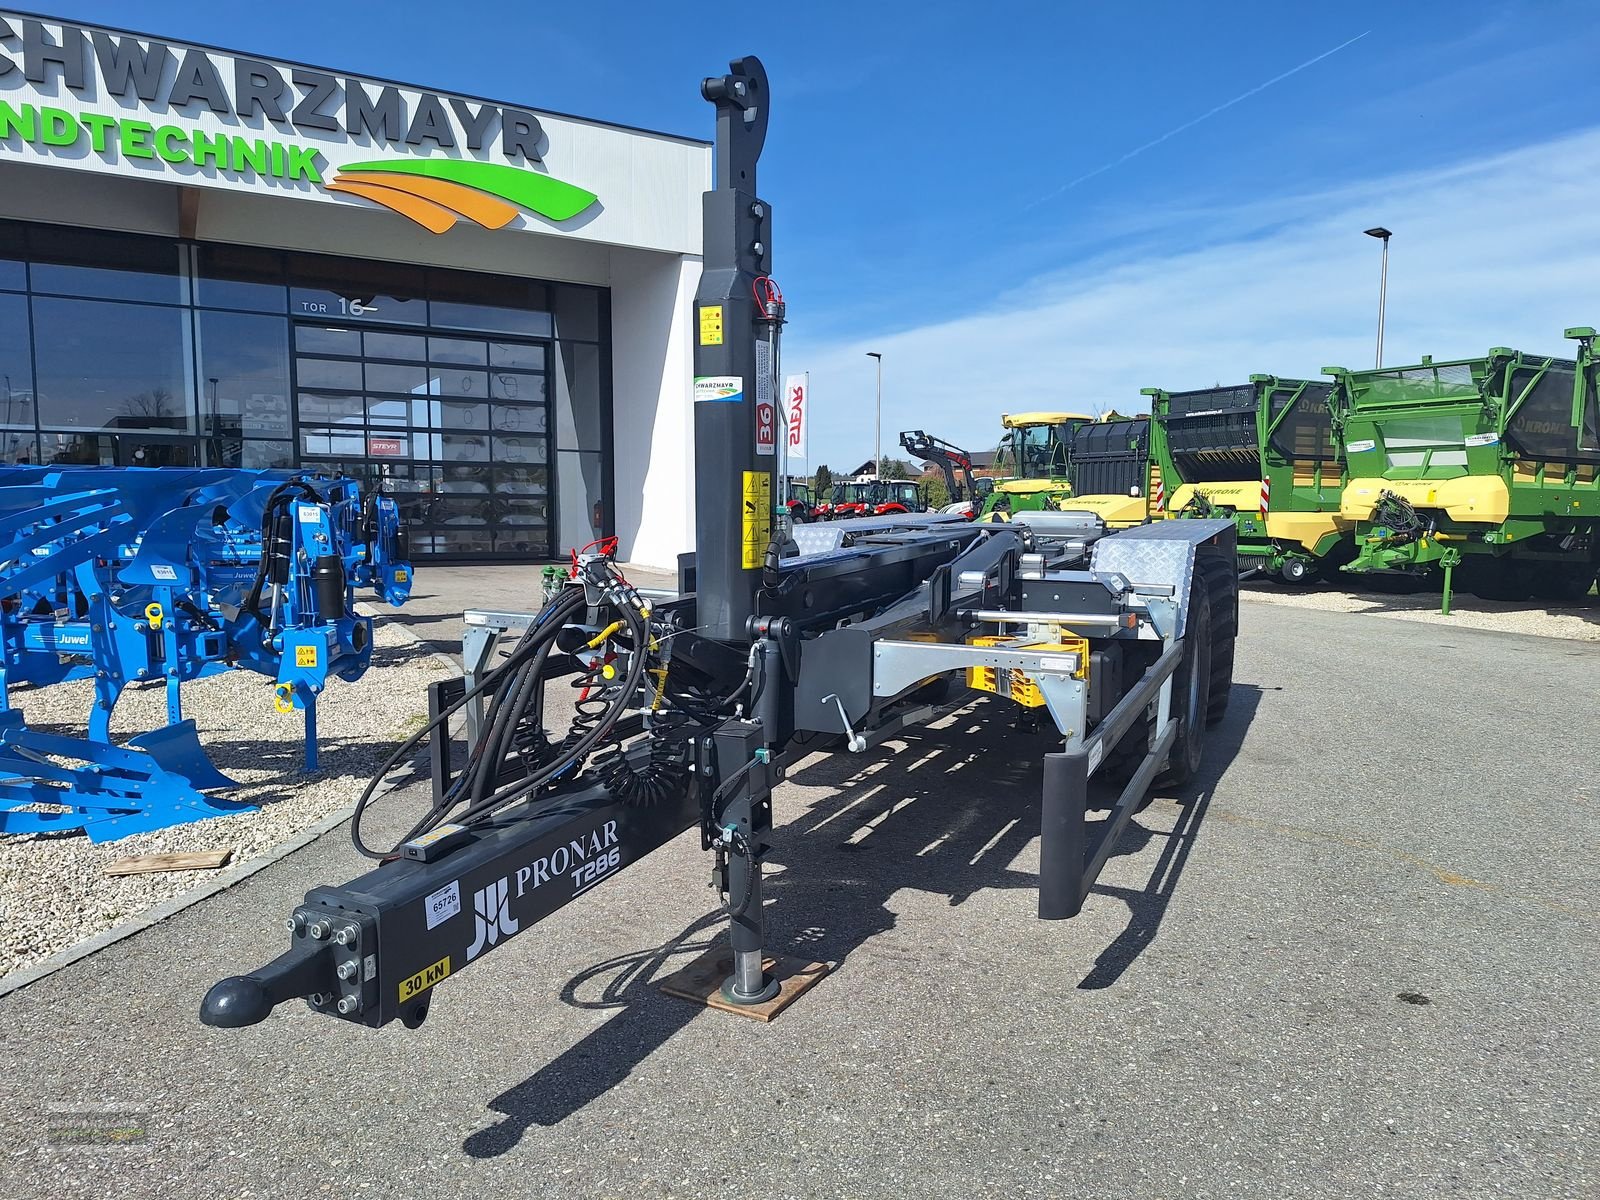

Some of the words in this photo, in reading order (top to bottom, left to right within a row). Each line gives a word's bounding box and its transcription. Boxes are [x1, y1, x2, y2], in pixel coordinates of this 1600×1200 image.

[302, 302, 327, 313] TOR
[339, 297, 364, 316] 16
[760, 407, 771, 441] 36
[1525, 420, 1568, 434] KRONE
[60, 634, 89, 645] Juwel
[515, 819, 619, 899] PRONAR
[571, 846, 621, 888] T286
[433, 892, 457, 912] 65726
[405, 976, 422, 996] 30
[427, 962, 444, 982] kN
